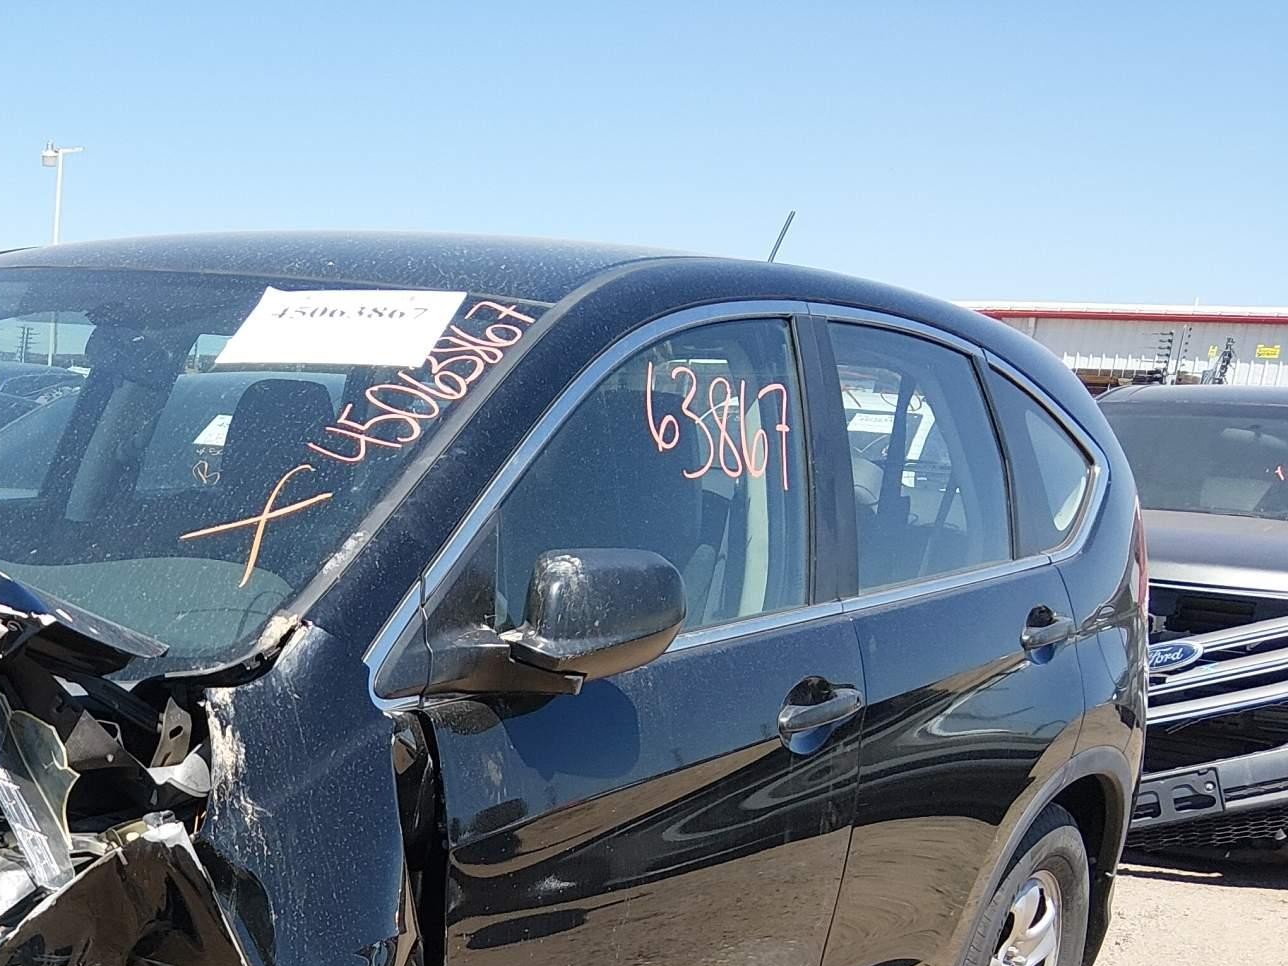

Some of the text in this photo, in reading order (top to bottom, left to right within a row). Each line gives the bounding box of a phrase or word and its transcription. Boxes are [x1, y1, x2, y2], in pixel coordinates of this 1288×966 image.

[308, 300, 536, 462] 45063867
[646, 361, 790, 490] 63867
[1148, 646, 1184, 666] Ford
